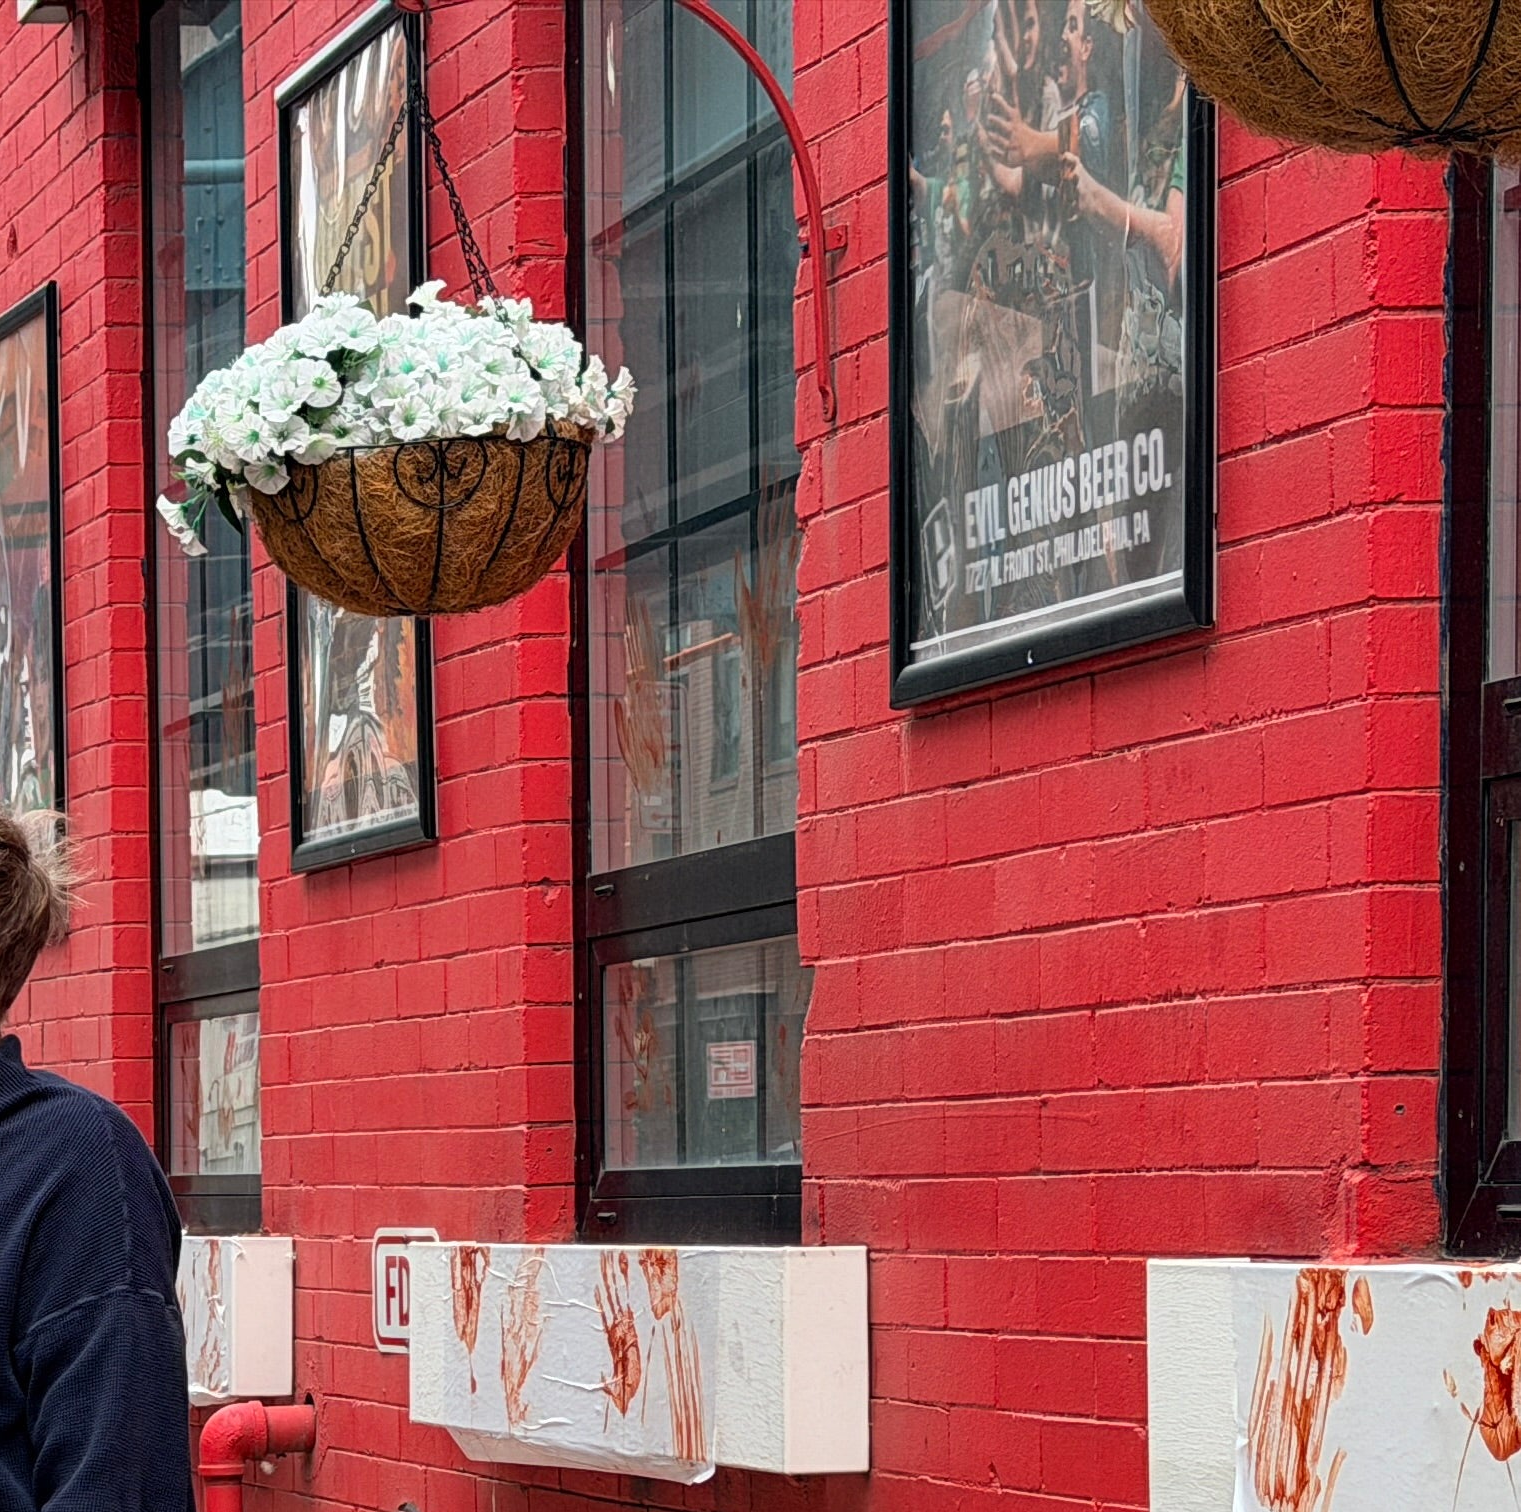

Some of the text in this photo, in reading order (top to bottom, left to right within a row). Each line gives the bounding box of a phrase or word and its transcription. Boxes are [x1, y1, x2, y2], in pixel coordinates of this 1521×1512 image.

[964, 428, 1172, 549] EVIL GENIUS BEER CO.
[1003, 544, 1037, 584] FRONT
[1036, 540, 1054, 576] ST,
[1053, 516, 1133, 569] PHILADELPHIA,
[1133, 509, 1151, 546] PA
